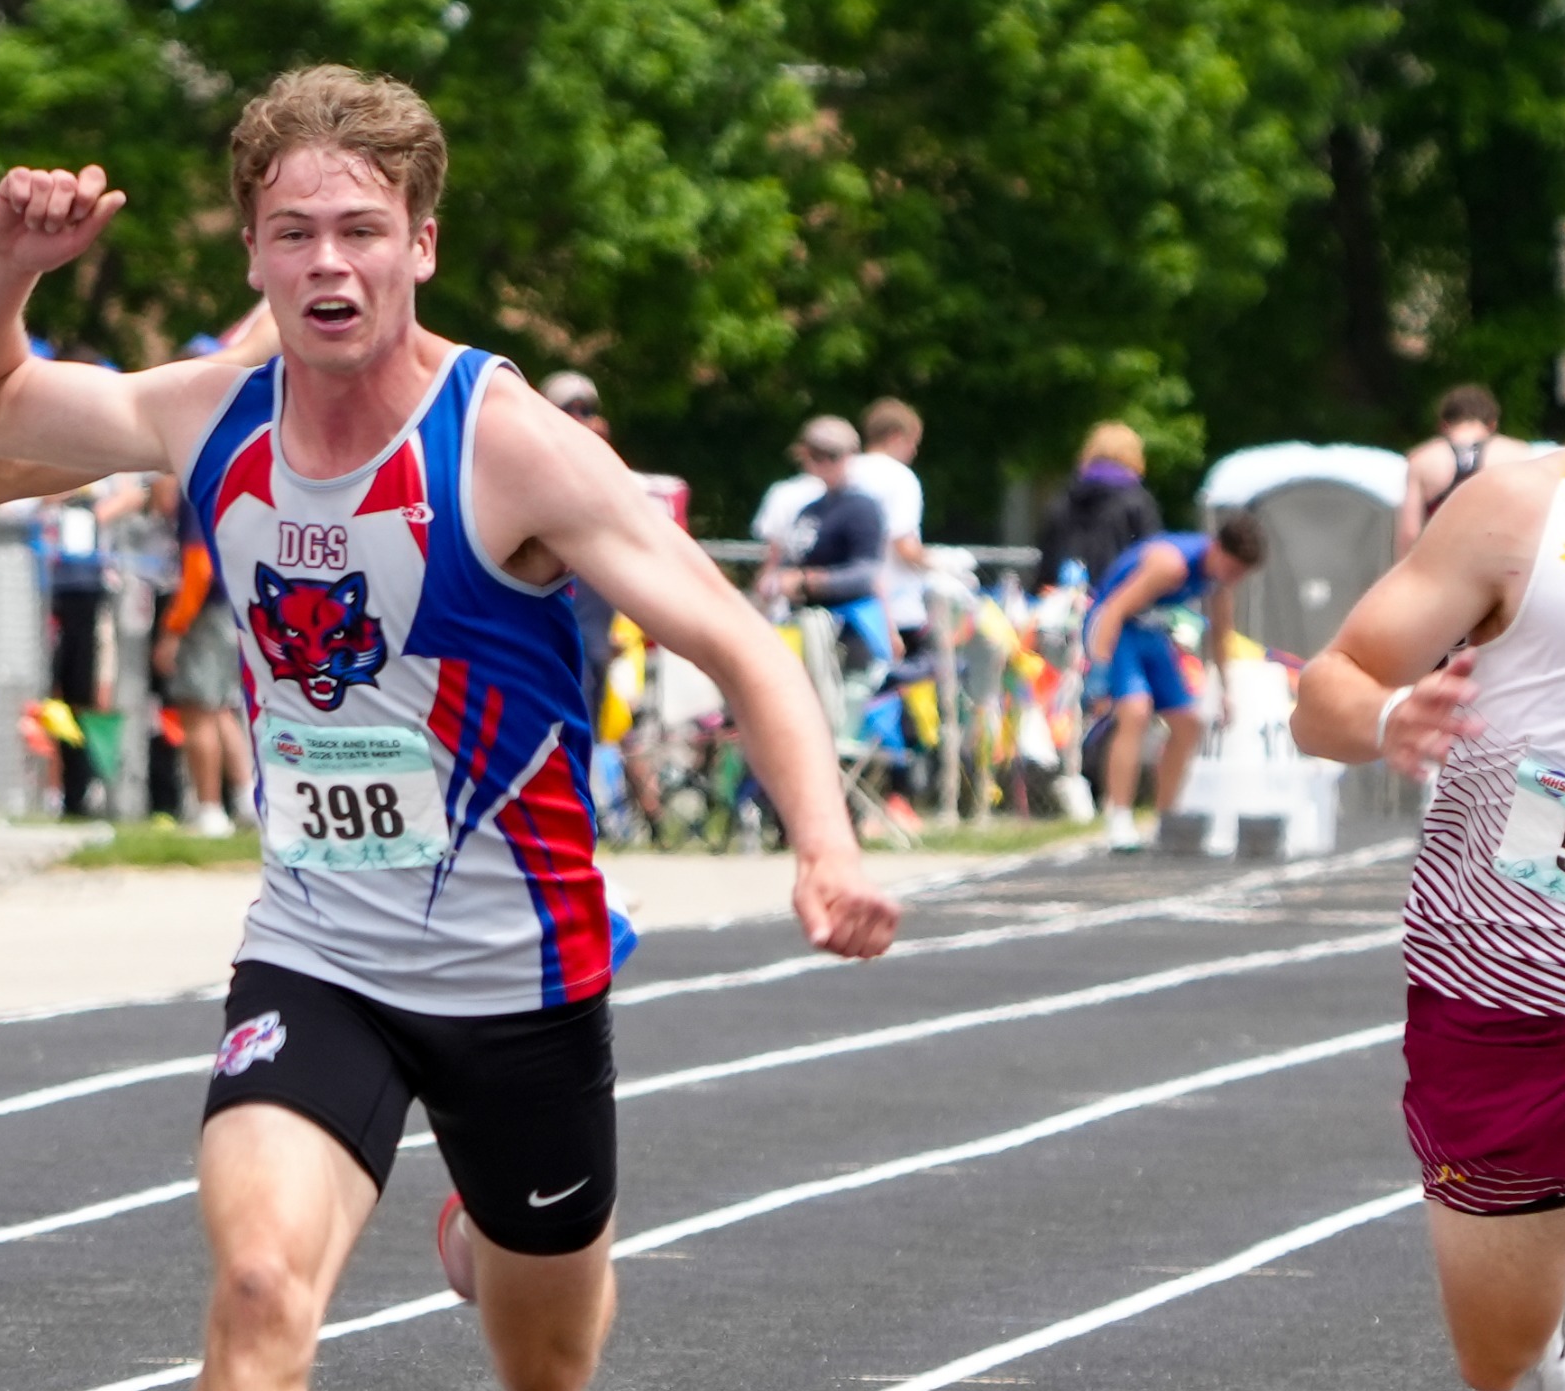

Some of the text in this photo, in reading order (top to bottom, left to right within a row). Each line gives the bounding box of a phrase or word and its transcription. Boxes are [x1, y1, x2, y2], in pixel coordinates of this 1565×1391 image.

[278, 520, 347, 571] DGS
[336, 750, 369, 760] STATE
[369, 739, 401, 749] FIELD
[296, 781, 404, 841] 398
